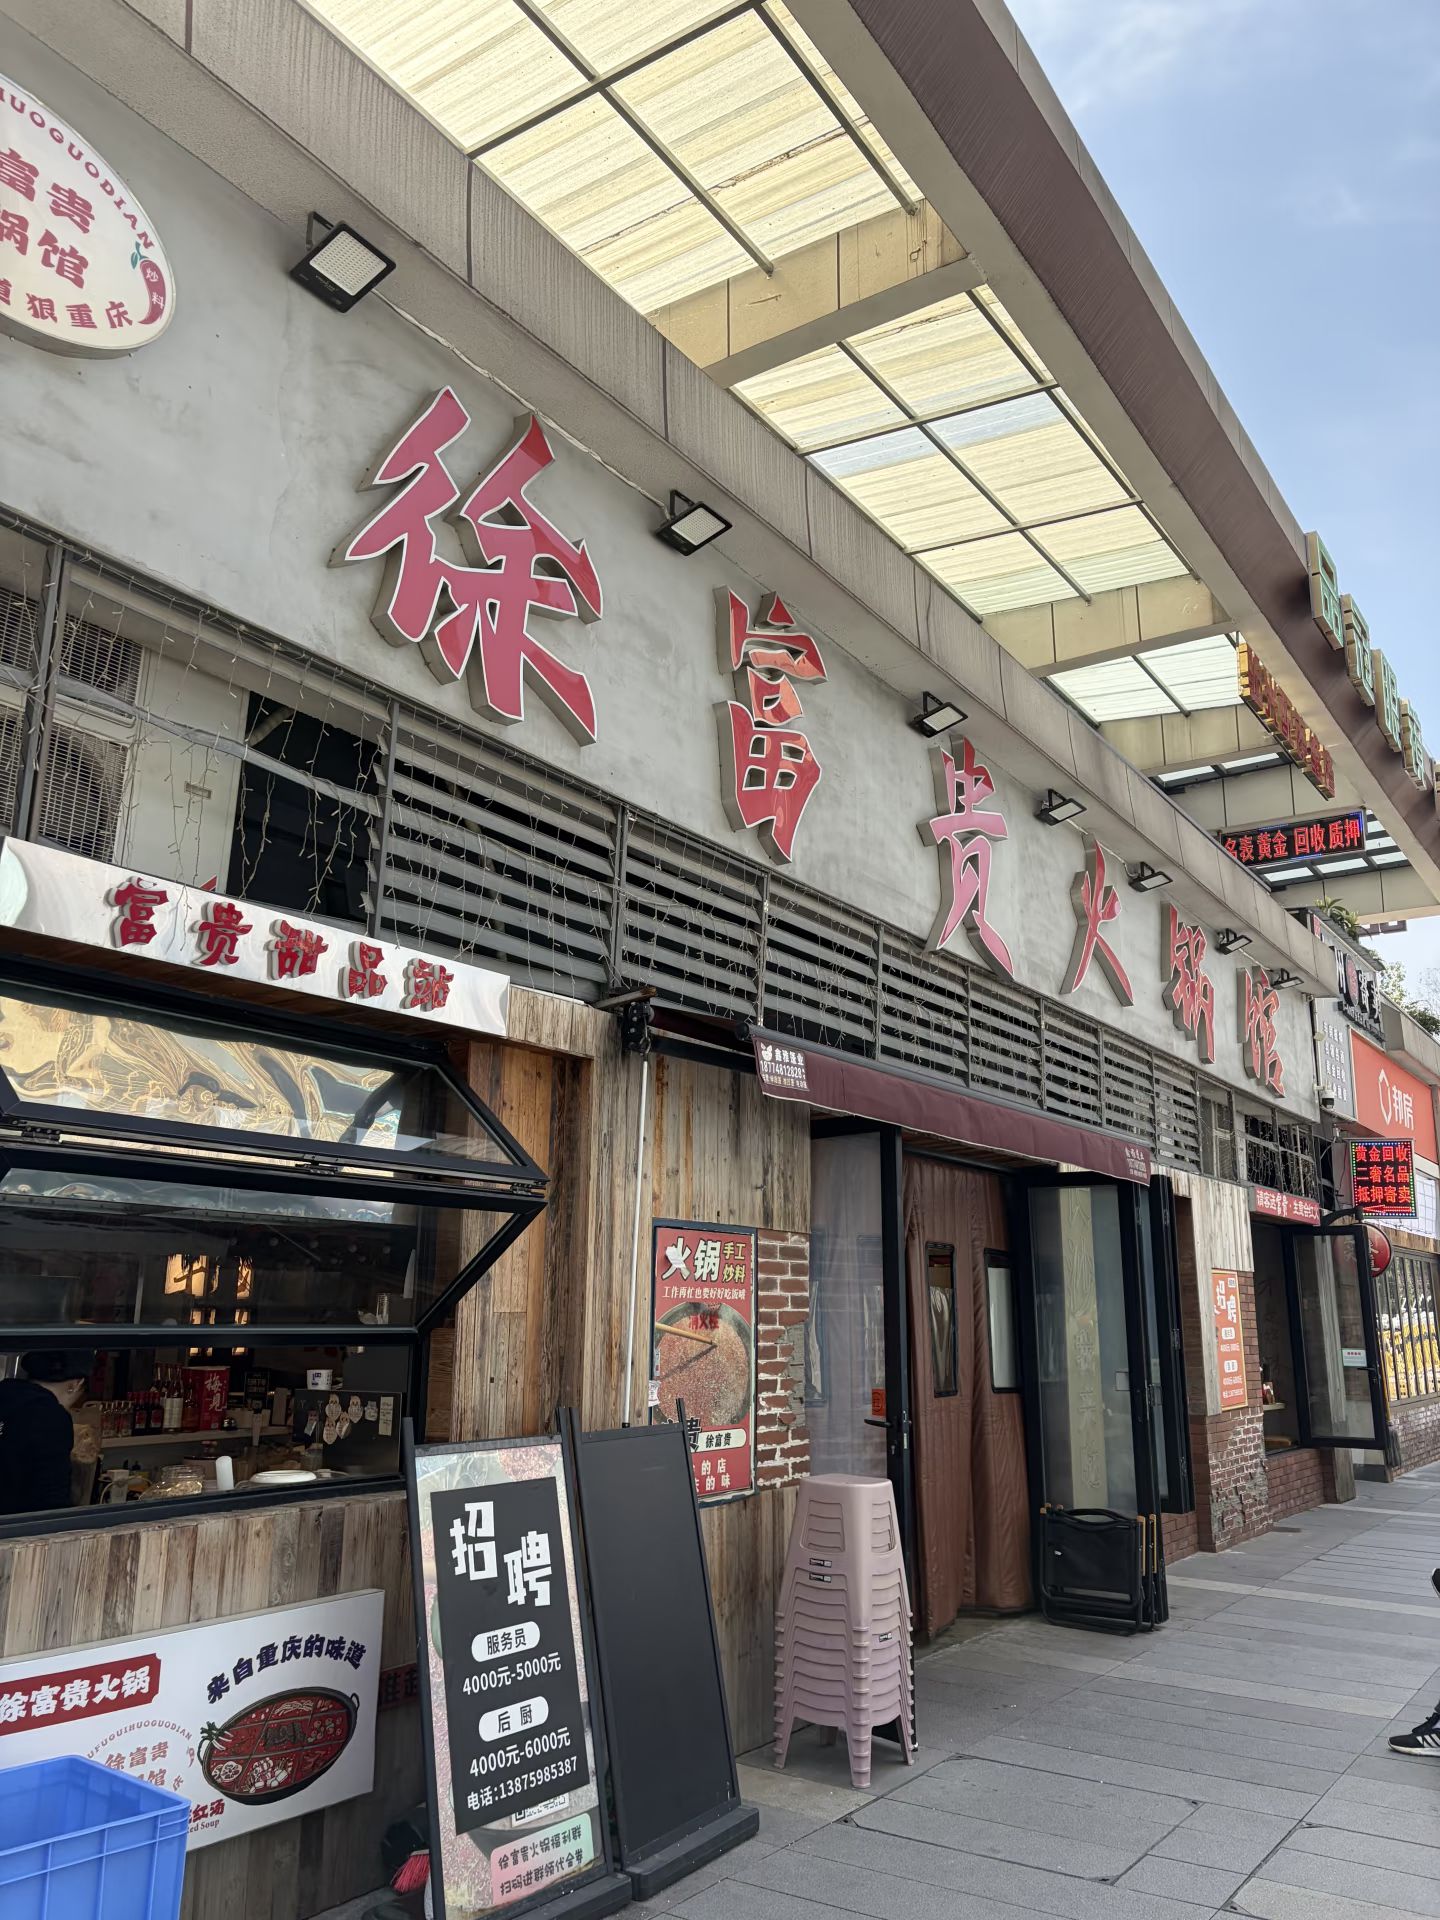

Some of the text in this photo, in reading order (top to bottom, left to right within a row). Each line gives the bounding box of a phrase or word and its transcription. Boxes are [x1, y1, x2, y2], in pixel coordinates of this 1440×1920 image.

[343, 386, 1286, 1098] 徐富贵火锅馆
[109, 876, 455, 1013] 富贵甜品站
[1355, 1145, 1408, 1162] 黄金回收
[1356, 1165, 1409, 1182] 二奢名品
[1357, 1186, 1411, 1203] 抵押寄卖
[661, 1236, 721, 1282] 火锅
[722, 1264, 746, 1283] 炒料
[723, 1242, 746, 1261] 手工
[662, 1285, 746, 1300] 工作再忙也要好好吃饭哦
[705, 1432, 732, 1448] 徐富贵
[450, 1501, 552, 1606] 招聘
[486, 1628, 526, 1655] 服务员
[206, 1634, 367, 1704] 来自重庆的味道
[462, 1652, 562, 1696] 4000元-5000元
[0, 1665, 150, 1725] 徐富贵火锅
[469, 1727, 571, 1777] 4000元-6000元
[467, 1756, 577, 1811] 电话:13875985387
[201, 1819, 220, 1830] Soup
[498, 1824, 582, 1870] 徐富贵火锅福利群
[500, 1848, 584, 1897] 扫码进群领代金券
